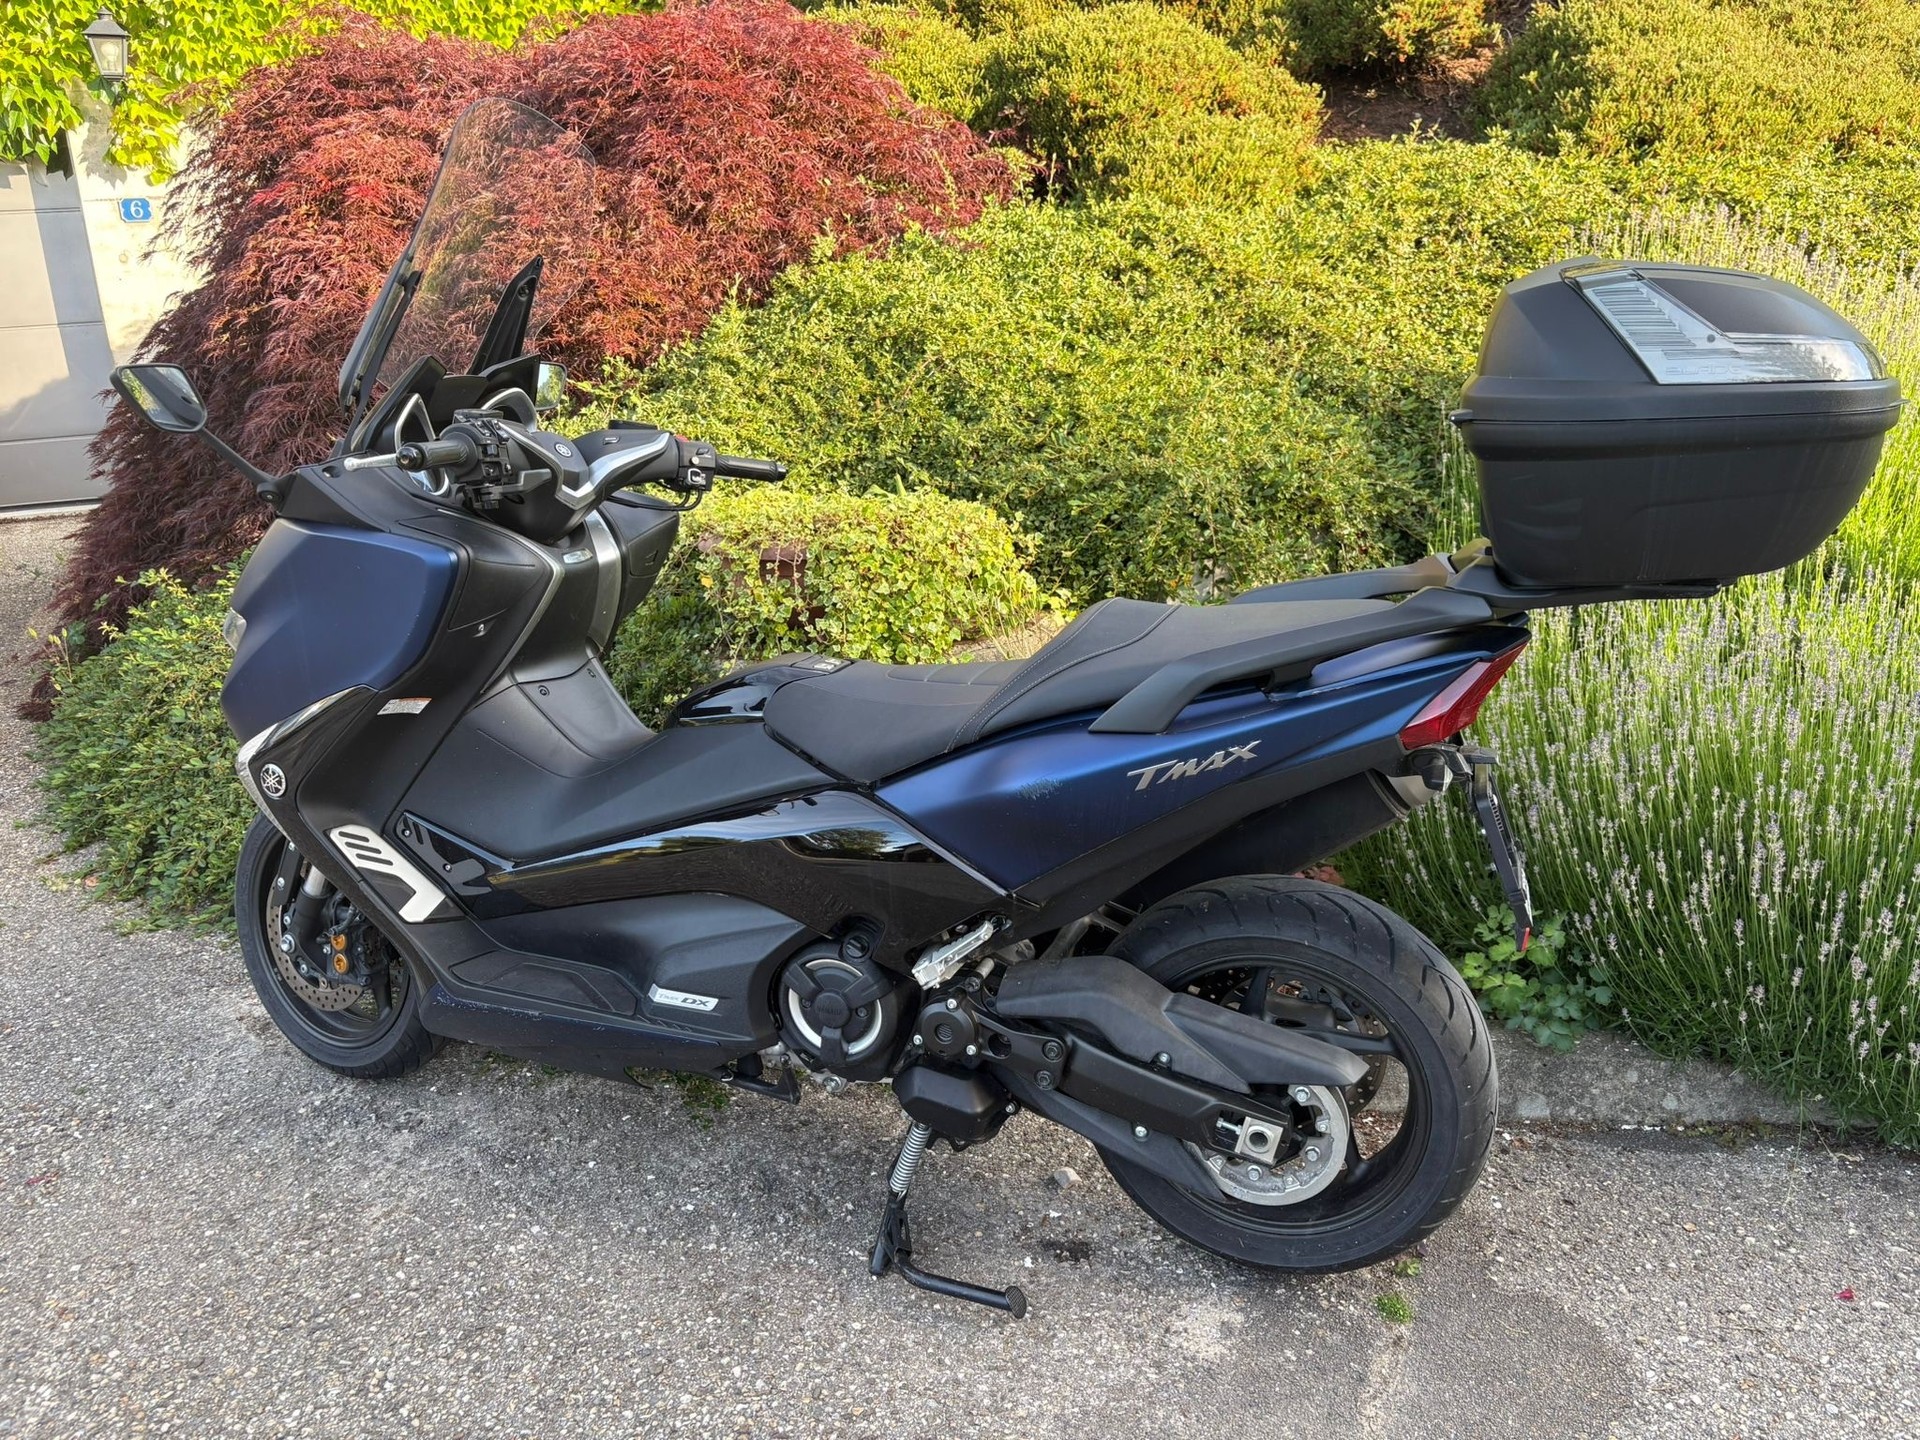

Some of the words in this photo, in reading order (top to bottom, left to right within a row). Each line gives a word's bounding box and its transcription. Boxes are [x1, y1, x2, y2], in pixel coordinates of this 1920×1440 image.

[130, 200, 144, 218] 6
[1127, 740, 1262, 791] TMAX
[681, 997, 710, 1007] DX
